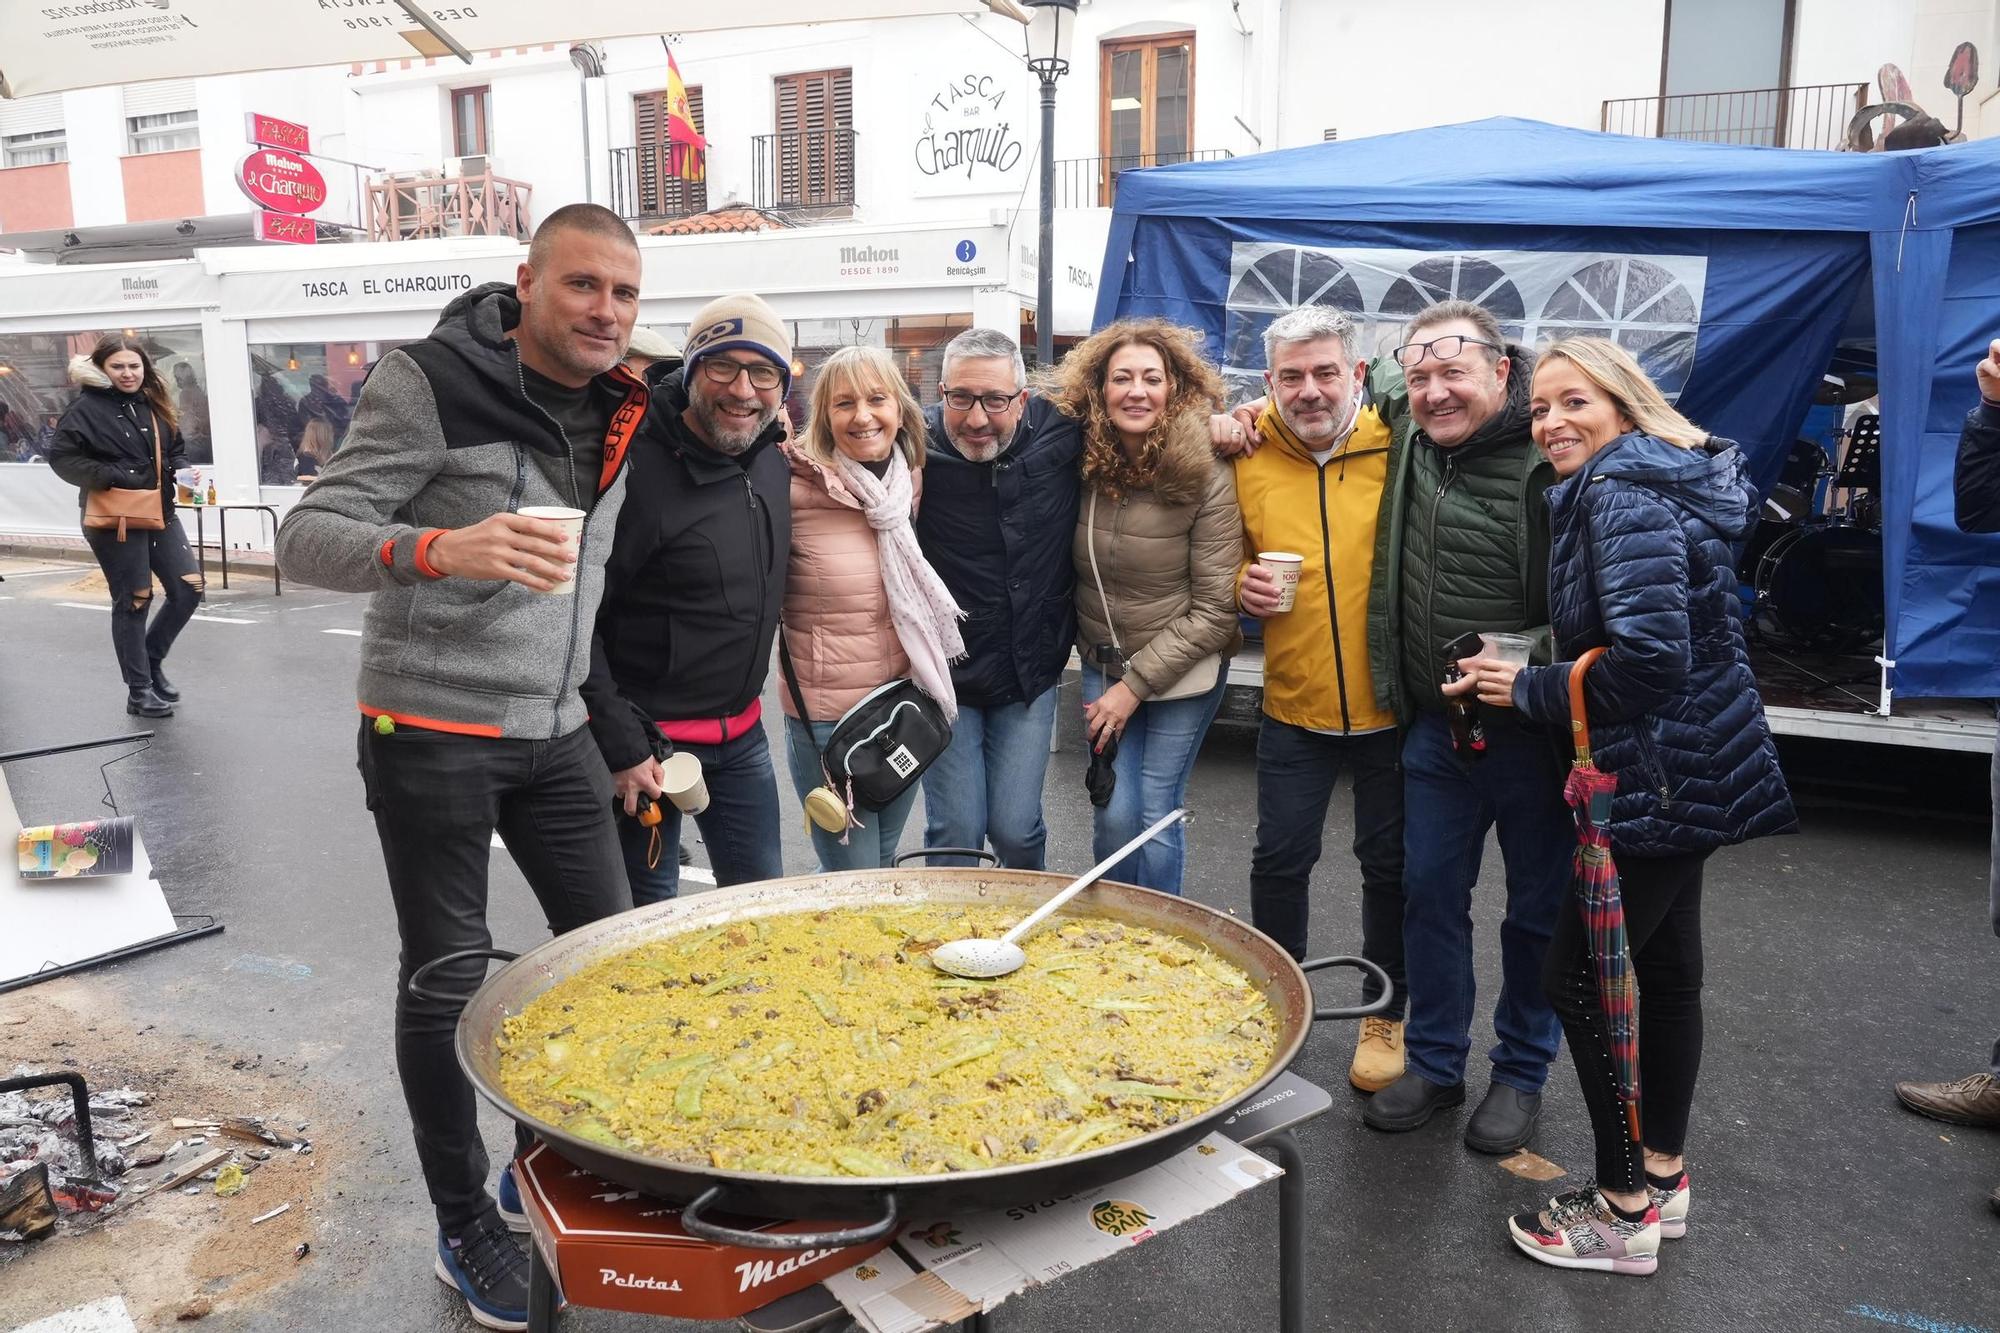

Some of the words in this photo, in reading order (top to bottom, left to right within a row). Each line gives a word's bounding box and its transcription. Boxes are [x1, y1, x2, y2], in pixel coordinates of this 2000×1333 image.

[931, 74, 1006, 111] TASCA
[963, 106, 980, 117] BAR
[261, 120, 305, 146] TASCA
[265, 153, 304, 173] Mahou
[915, 122, 1022, 181] Charquito
[270, 217, 312, 240] BAR
[839, 245, 900, 264] Mahou
[840, 267, 872, 276] DESDE
[876, 266, 899, 274] 1890
[1068, 265, 1094, 290] TASCA
[122, 276, 159, 291] Mahou
[302, 281, 349, 298] TASCA
[363, 279, 381, 295] EL
[384, 274, 472, 294] CHARQUITO
[1108, 1210, 1157, 1237] Vive
[931, 1241, 984, 1264] ALMENDRAS
[599, 1268, 683, 1292] Pelotas
